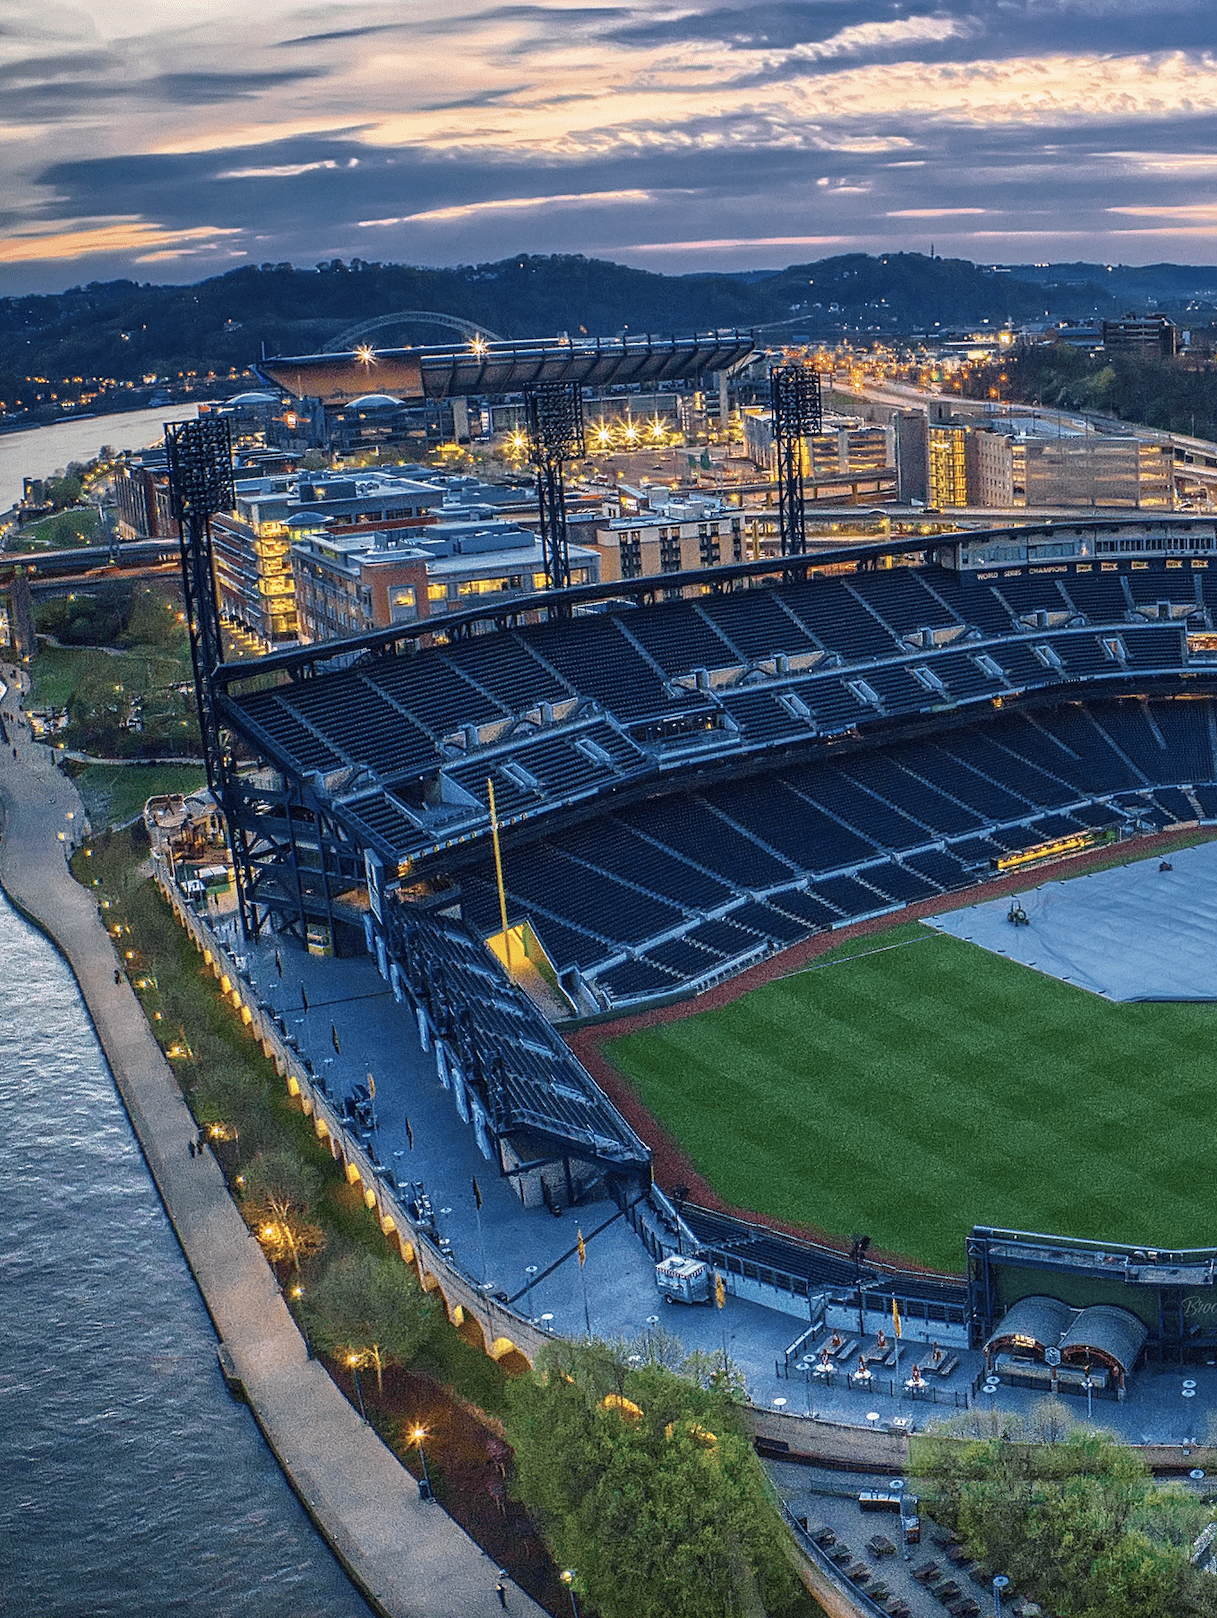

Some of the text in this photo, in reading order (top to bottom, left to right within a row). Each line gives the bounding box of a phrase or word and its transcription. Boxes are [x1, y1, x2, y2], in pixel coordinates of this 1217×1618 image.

[976, 571, 999, 581] WORLD
[1003, 568, 1023, 578] SERIES
[1028, 565, 1068, 574] CHAMPIONS
